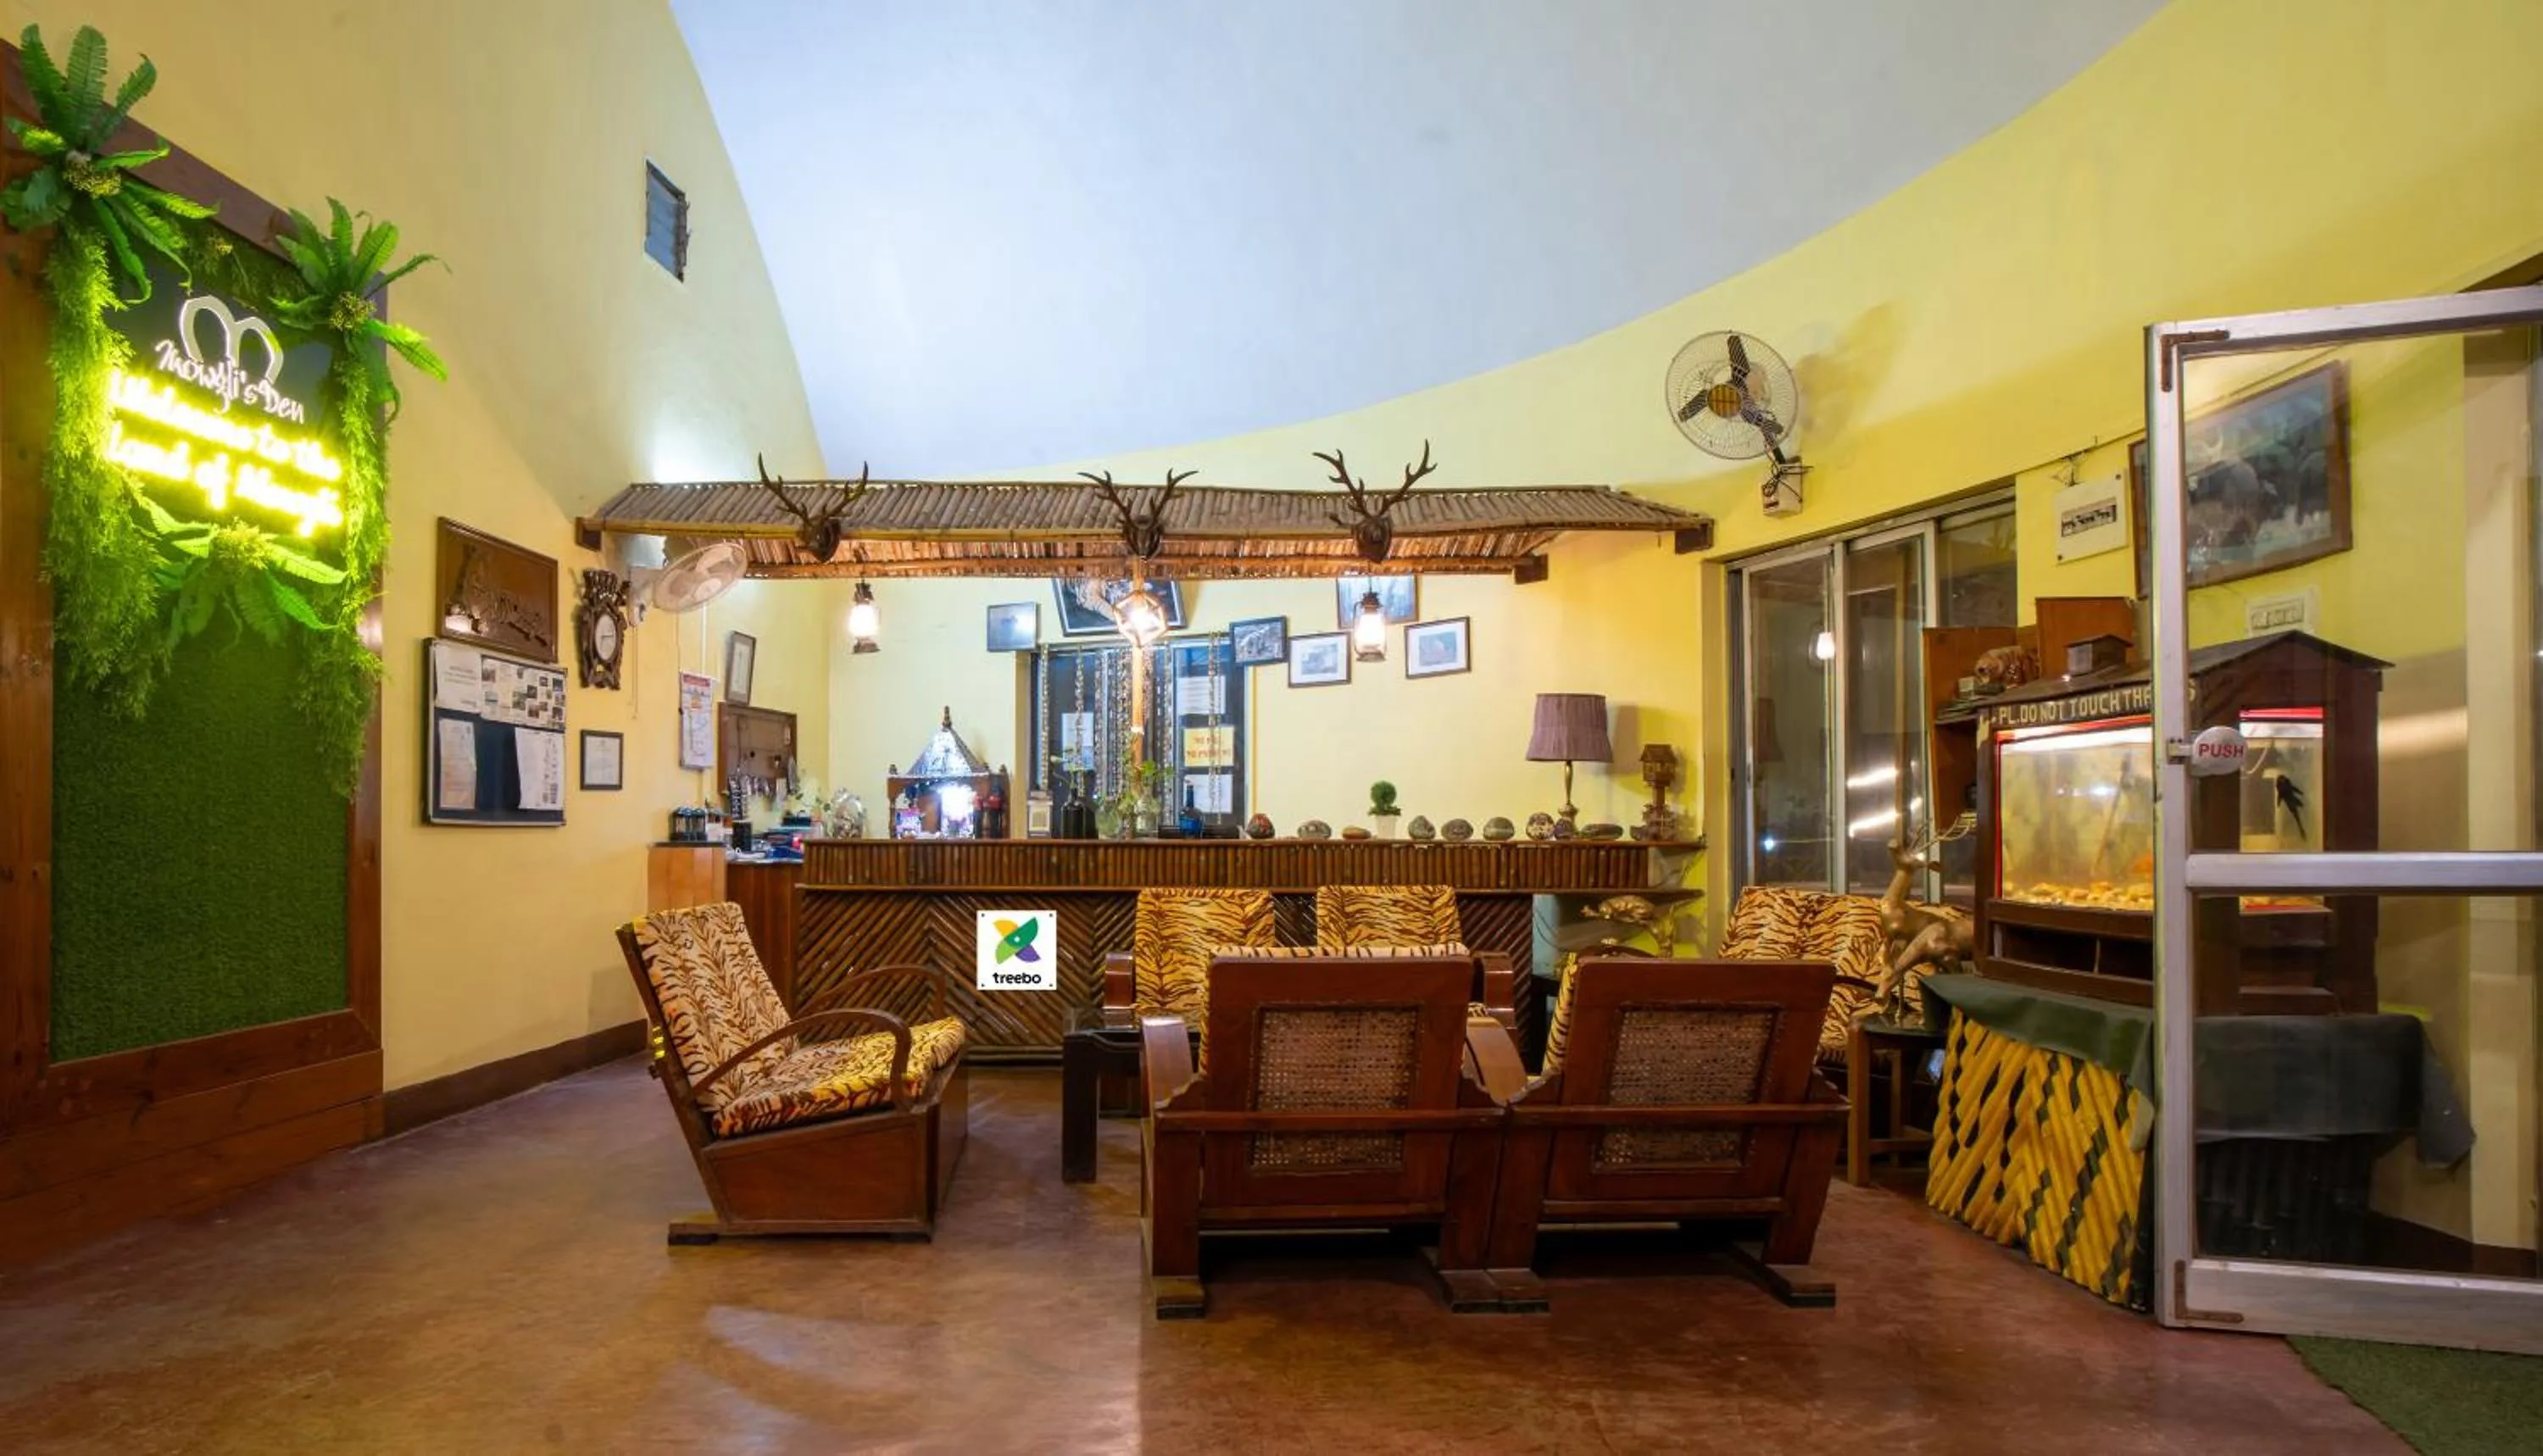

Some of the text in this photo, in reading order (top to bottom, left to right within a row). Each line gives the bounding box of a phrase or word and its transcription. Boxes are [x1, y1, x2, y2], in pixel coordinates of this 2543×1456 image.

[154, 339, 303, 424] Mowgli's Den
[2039, 700, 2066, 723] NOT
[2070, 690, 2120, 718] TOUCH
[2198, 742, 2244, 758] PUSH
[993, 972, 1042, 984] treebo
